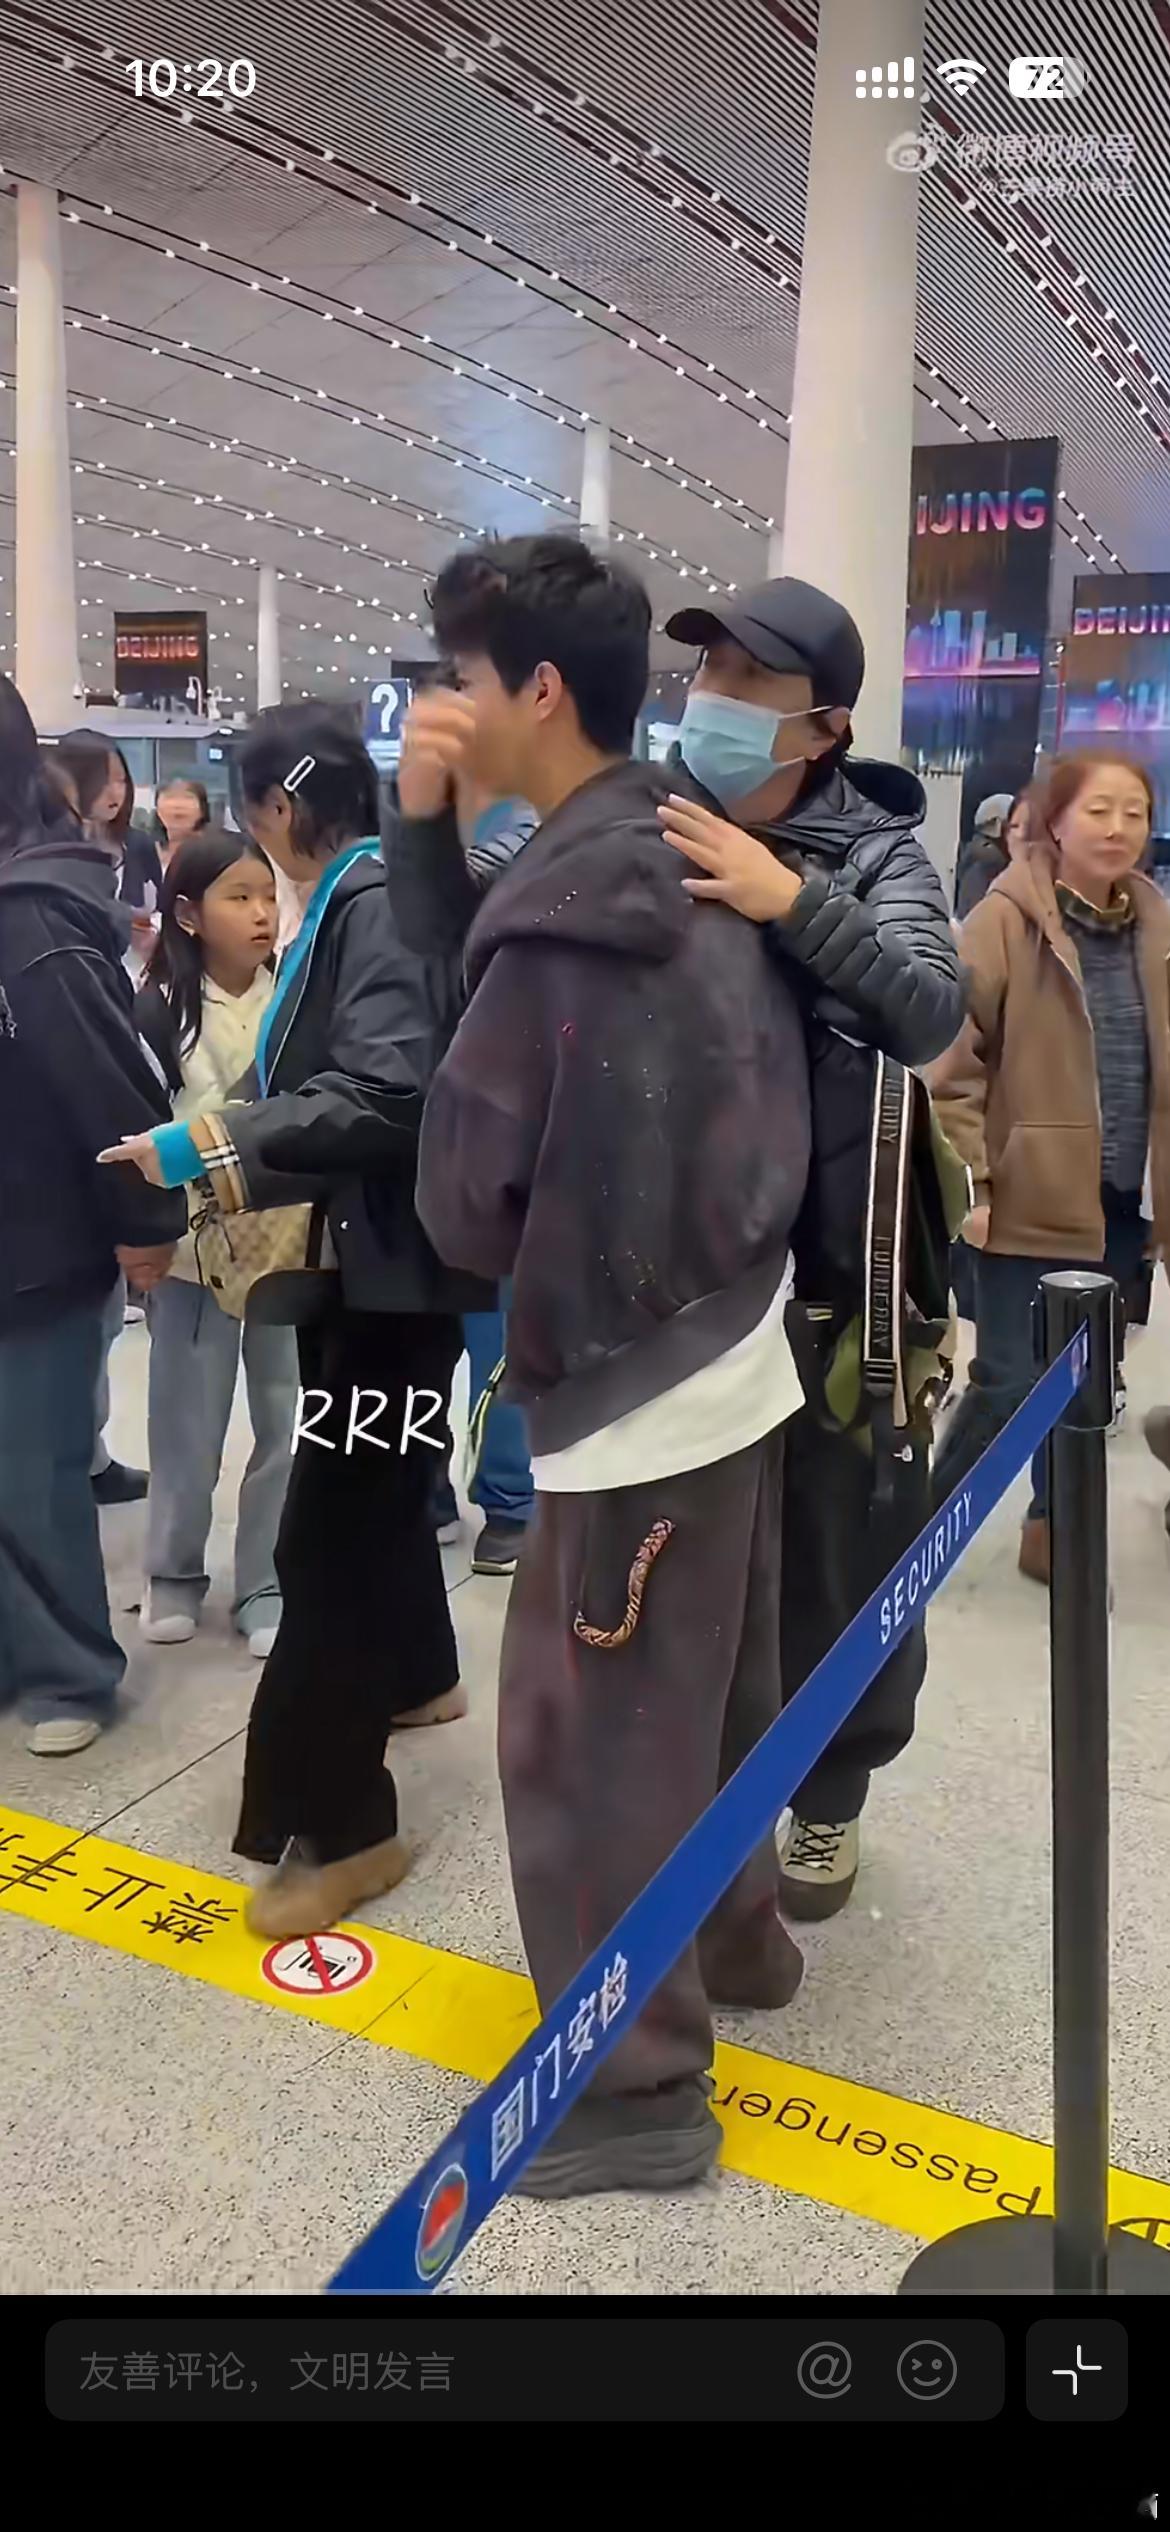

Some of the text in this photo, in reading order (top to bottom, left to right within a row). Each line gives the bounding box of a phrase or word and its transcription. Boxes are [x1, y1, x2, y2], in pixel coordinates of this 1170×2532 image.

[916, 487, 1046, 535] IJING
[880, 1491, 973, 1645] SECURITY
[491, 1951, 629, 2182] 国门安检
[712, 2085, 1042, 2216] Passenger
